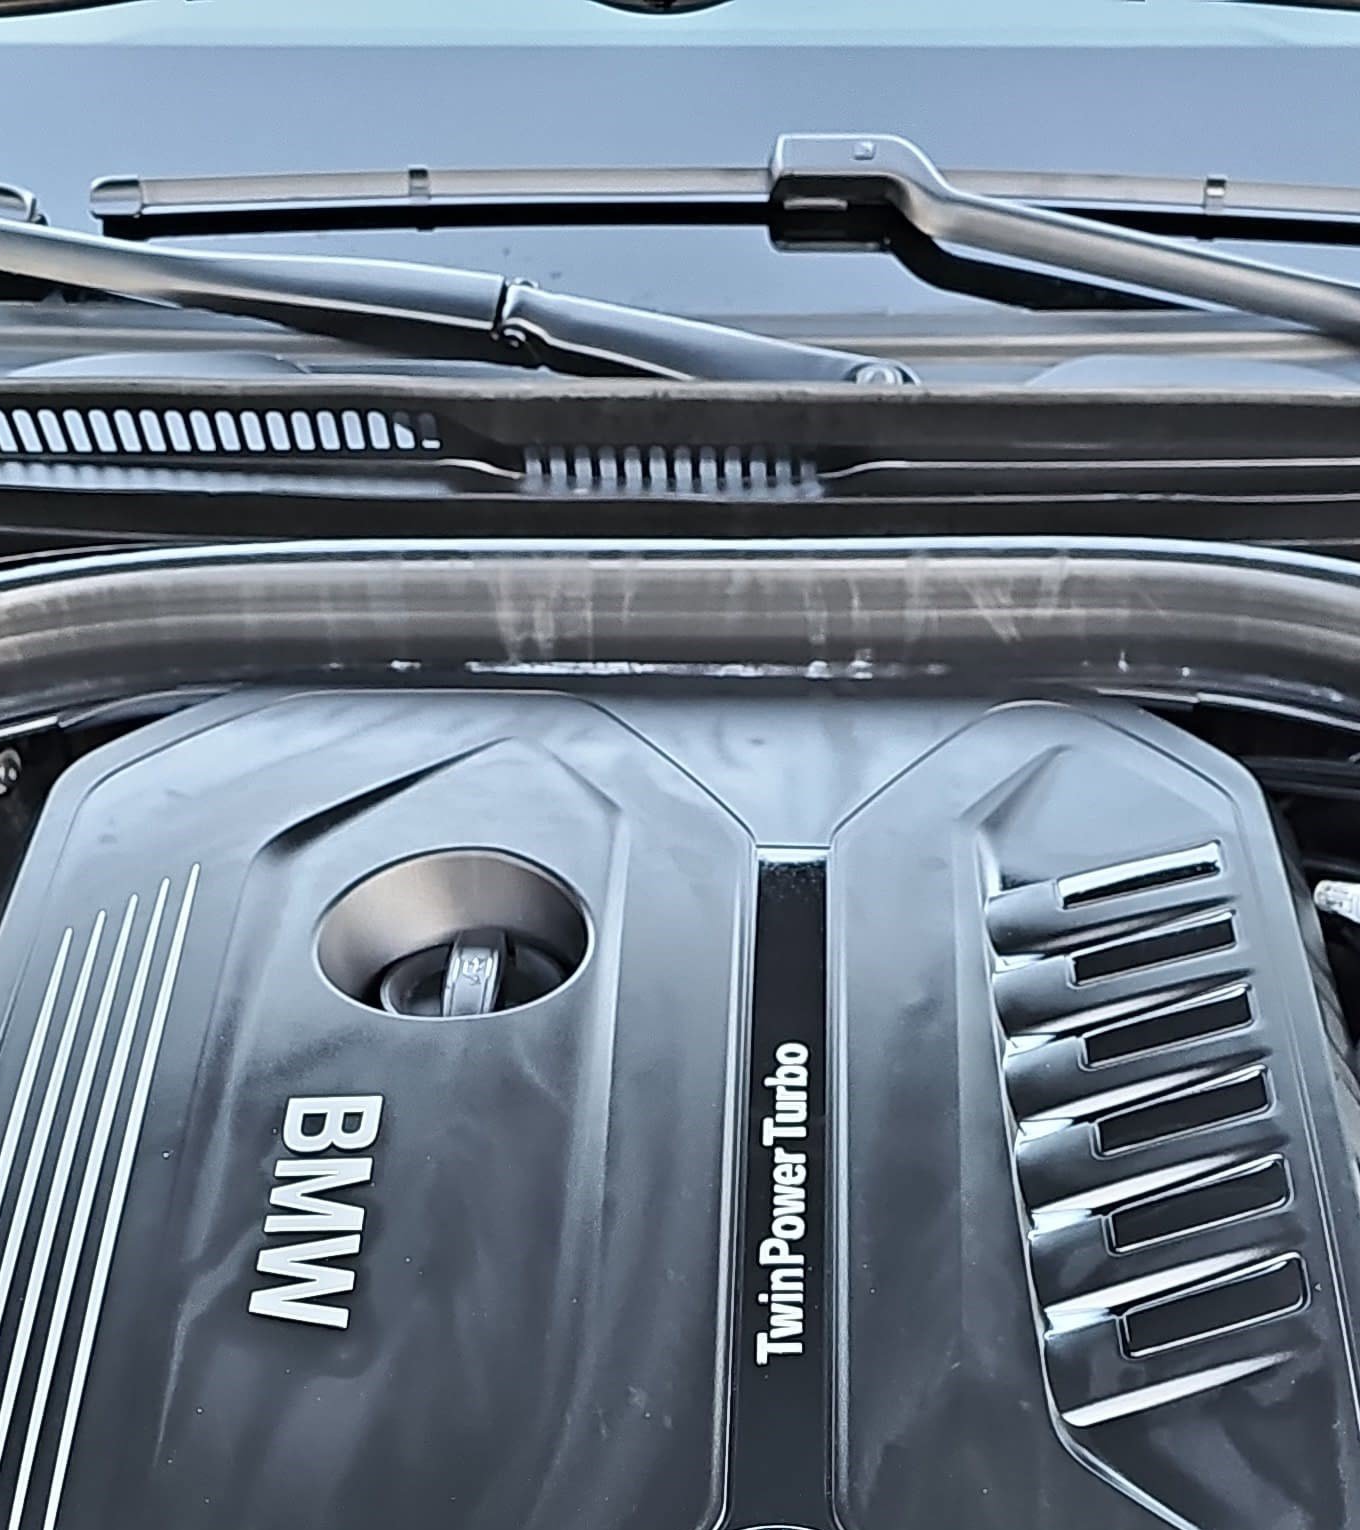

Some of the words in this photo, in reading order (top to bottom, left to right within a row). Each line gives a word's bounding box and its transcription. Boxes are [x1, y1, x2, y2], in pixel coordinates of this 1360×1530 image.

[762, 1042, 810, 1146] Turbo
[248, 1095, 384, 1329] BMW
[755, 1145, 808, 1364] TwinPower
